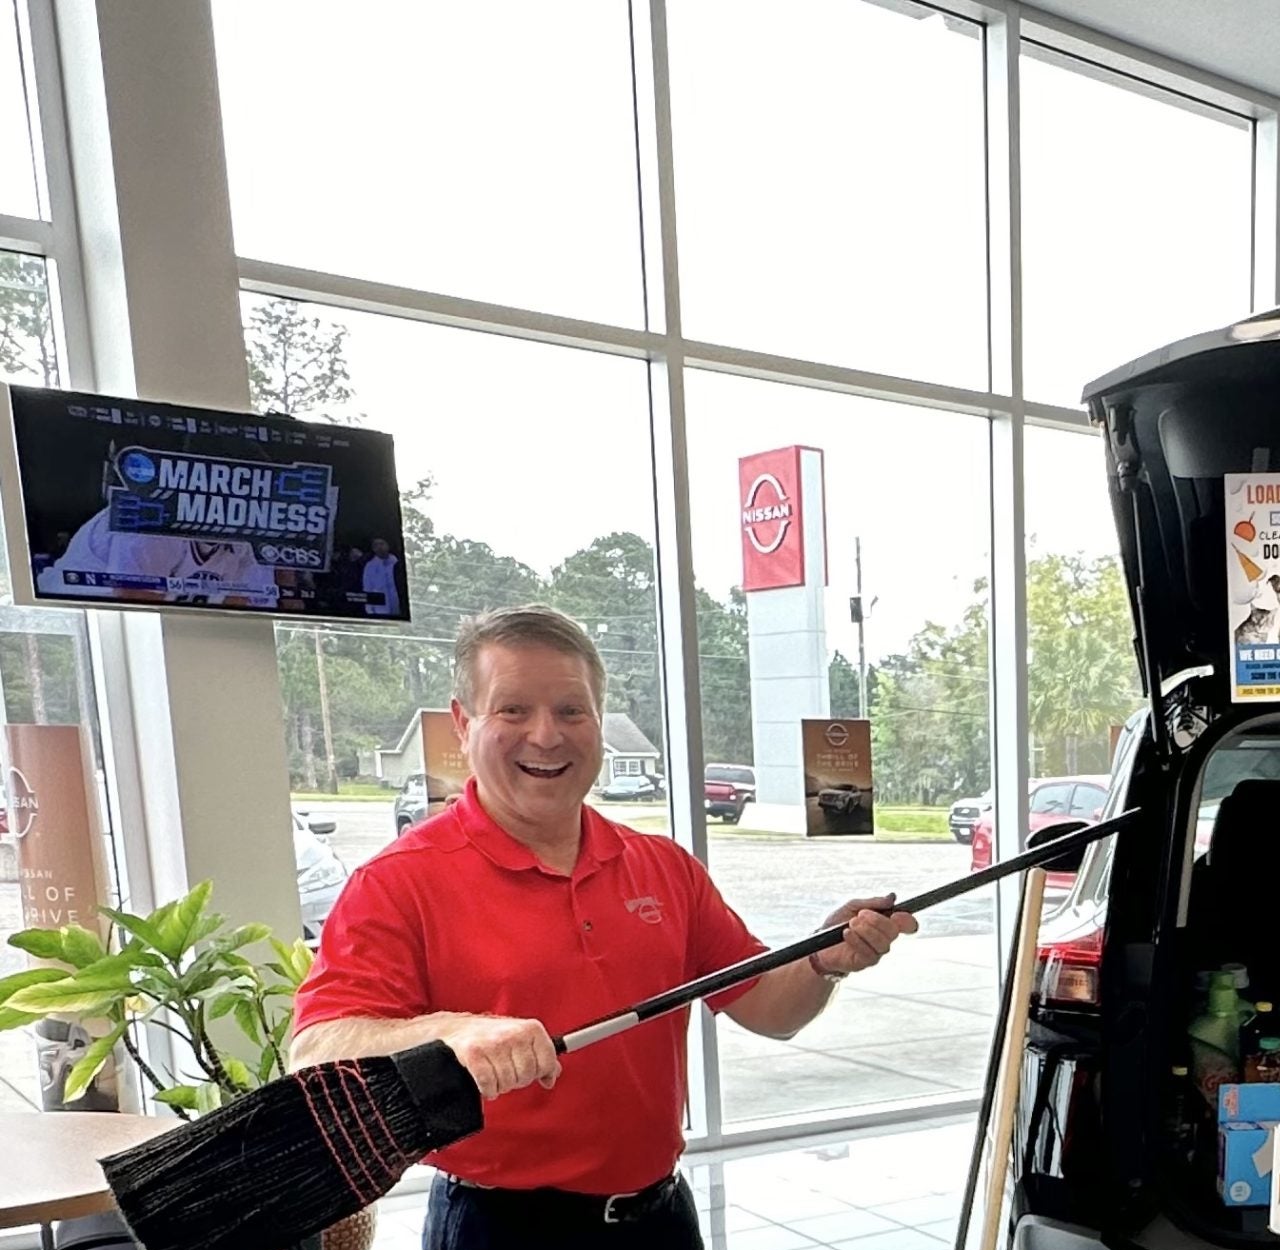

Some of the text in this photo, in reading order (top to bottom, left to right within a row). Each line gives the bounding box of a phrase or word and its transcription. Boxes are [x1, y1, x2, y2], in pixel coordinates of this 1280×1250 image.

[158, 459, 272, 498] MARCH
[176, 493, 328, 535] MADNESS
[743, 504, 791, 523] NISSAN
[281, 546, 321, 566] CBS
[46, 886, 75, 901] OF
